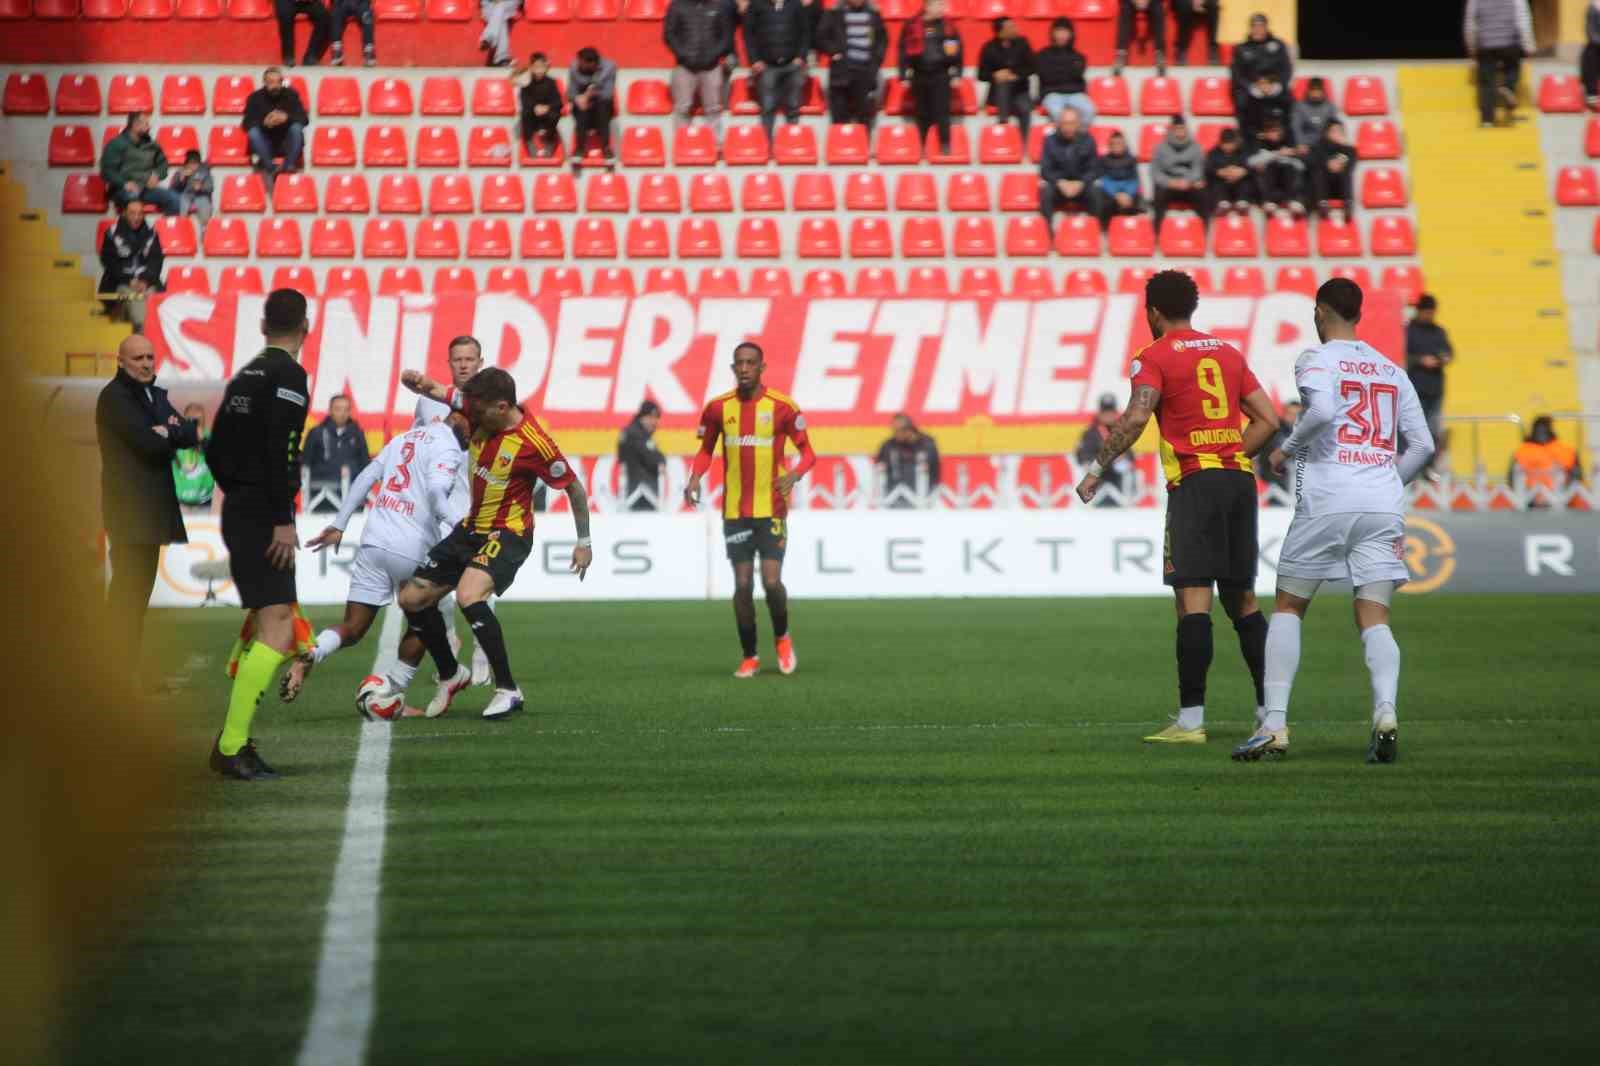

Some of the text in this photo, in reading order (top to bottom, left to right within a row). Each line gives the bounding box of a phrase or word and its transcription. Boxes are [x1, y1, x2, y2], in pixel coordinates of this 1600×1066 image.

[472, 292, 771, 414] DERT
[1196, 357, 1229, 419] 9
[1337, 379, 1398, 452] 30
[386, 441, 416, 493] 3
